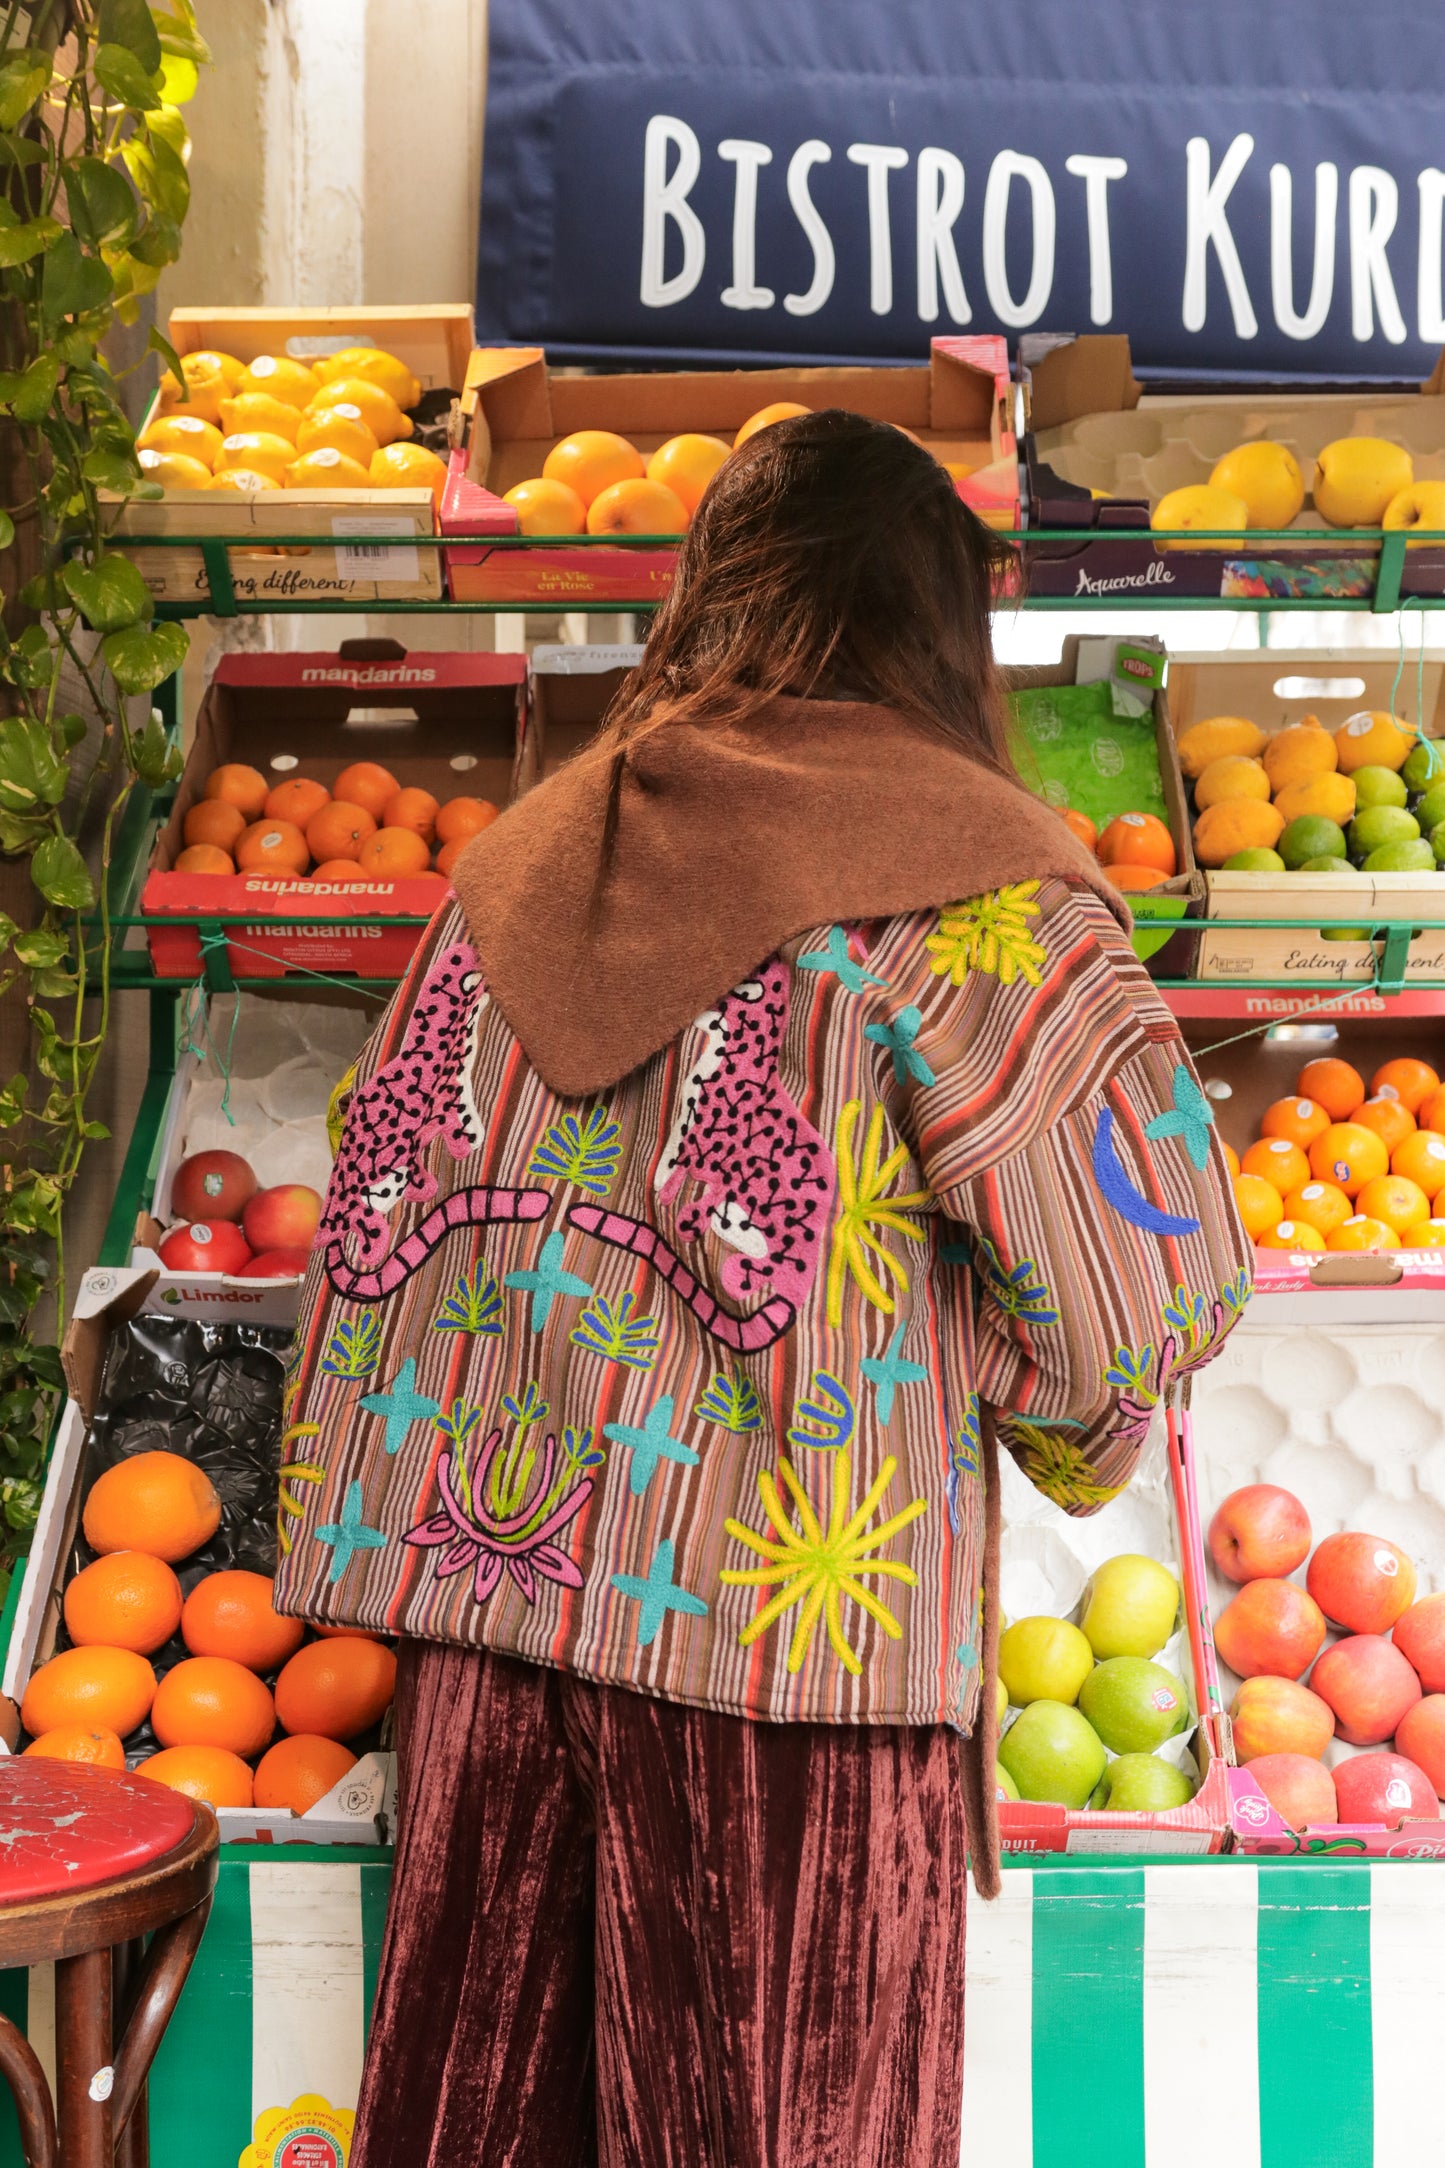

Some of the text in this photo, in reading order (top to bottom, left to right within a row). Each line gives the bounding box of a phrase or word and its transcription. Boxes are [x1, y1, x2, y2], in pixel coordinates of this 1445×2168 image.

[640, 114, 1128, 328] BISTROT
[560, 581, 595, 591] Rose
[564, 571, 591, 582] Vie
[1074, 560, 1177, 598] Aquarelle
[301, 664, 436, 684] mandarins
[245, 880, 395, 896] mandarins
[1284, 950, 1350, 975] Eating
[1246, 994, 1386, 1013] mandarins
[181, 1288, 264, 1303] Limdor
